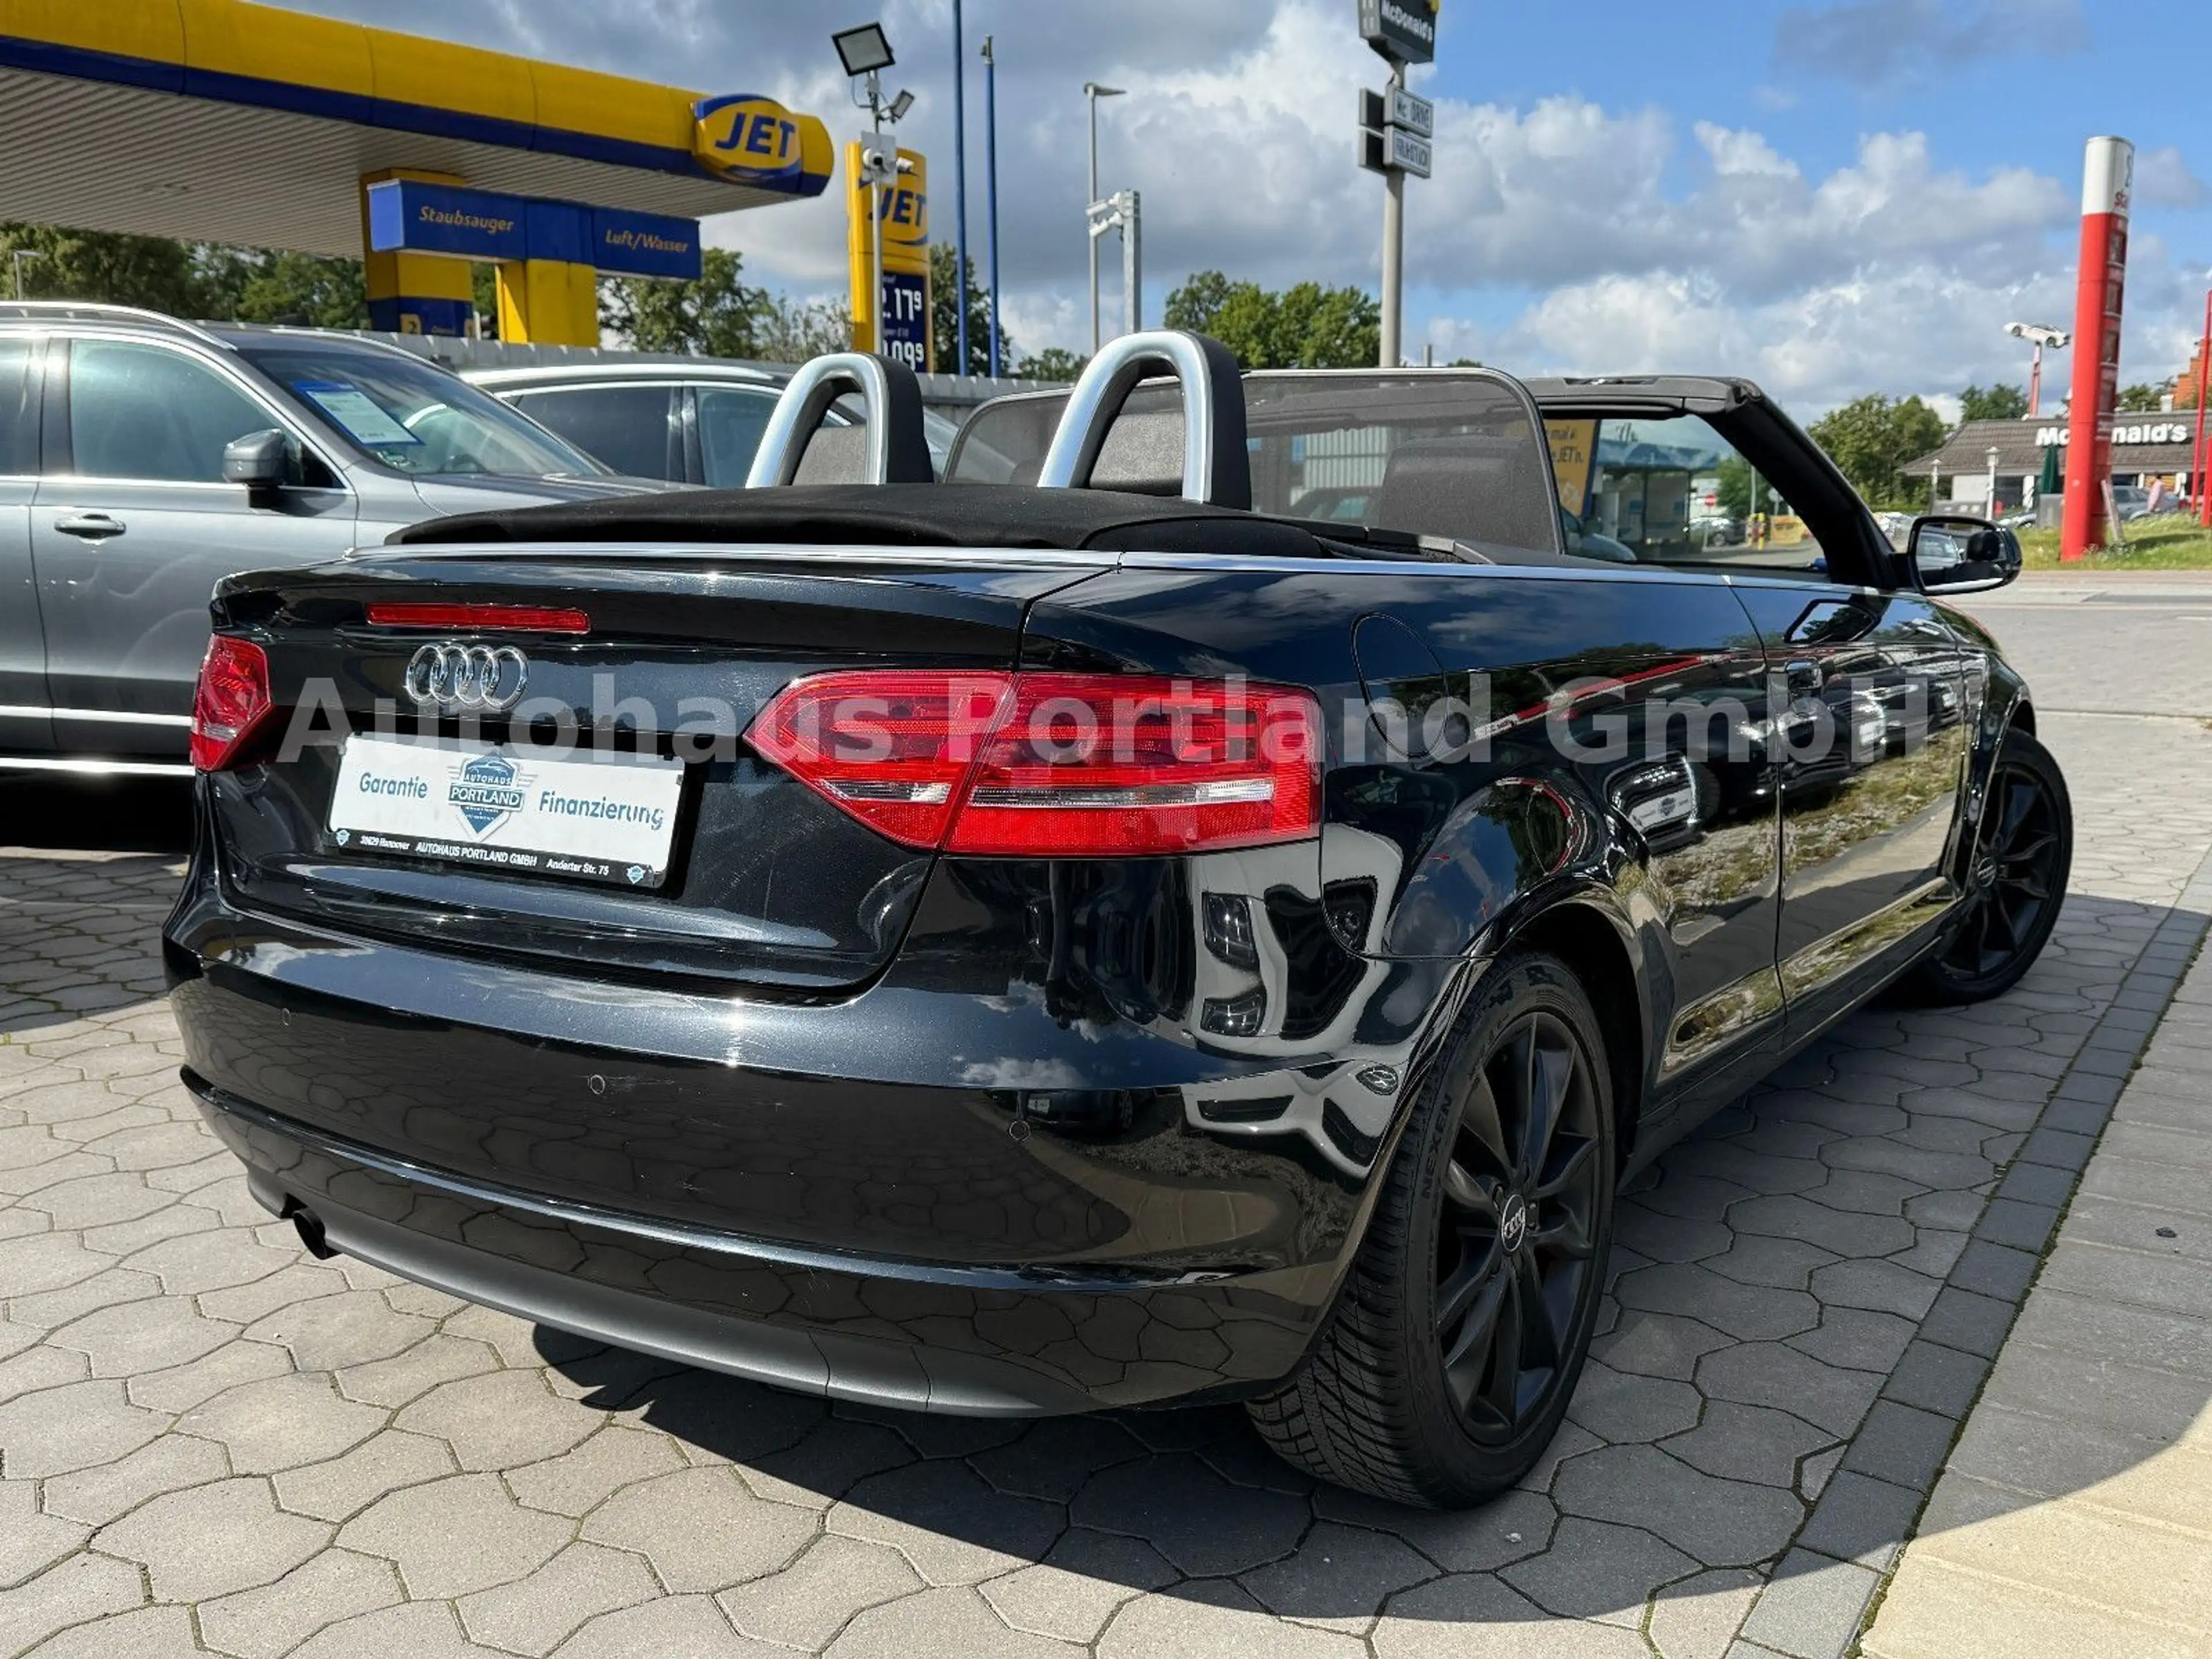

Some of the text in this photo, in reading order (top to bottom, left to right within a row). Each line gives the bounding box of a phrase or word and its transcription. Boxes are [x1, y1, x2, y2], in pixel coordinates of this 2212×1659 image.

[715, 112, 796, 158] JET
[419, 205, 514, 234] Staubsauger
[868, 187, 927, 228] JET
[605, 229, 689, 253] Luft/Wasser
[2035, 423, 2187, 446] Mcnald's
[359, 772, 428, 798] Garantie
[464, 774, 512, 785] AUTOHAUS
[451, 787, 520, 806] PORTLAND
[539, 790, 664, 831] Finanzierung
[415, 841, 460, 857] AUTOHAUS
[461, 847, 508, 863] PORTLAND
[510, 853, 537, 866] GMBH
[583, 863, 597, 874] Str.
[1421, 1092, 1453, 1199] NEXEN
